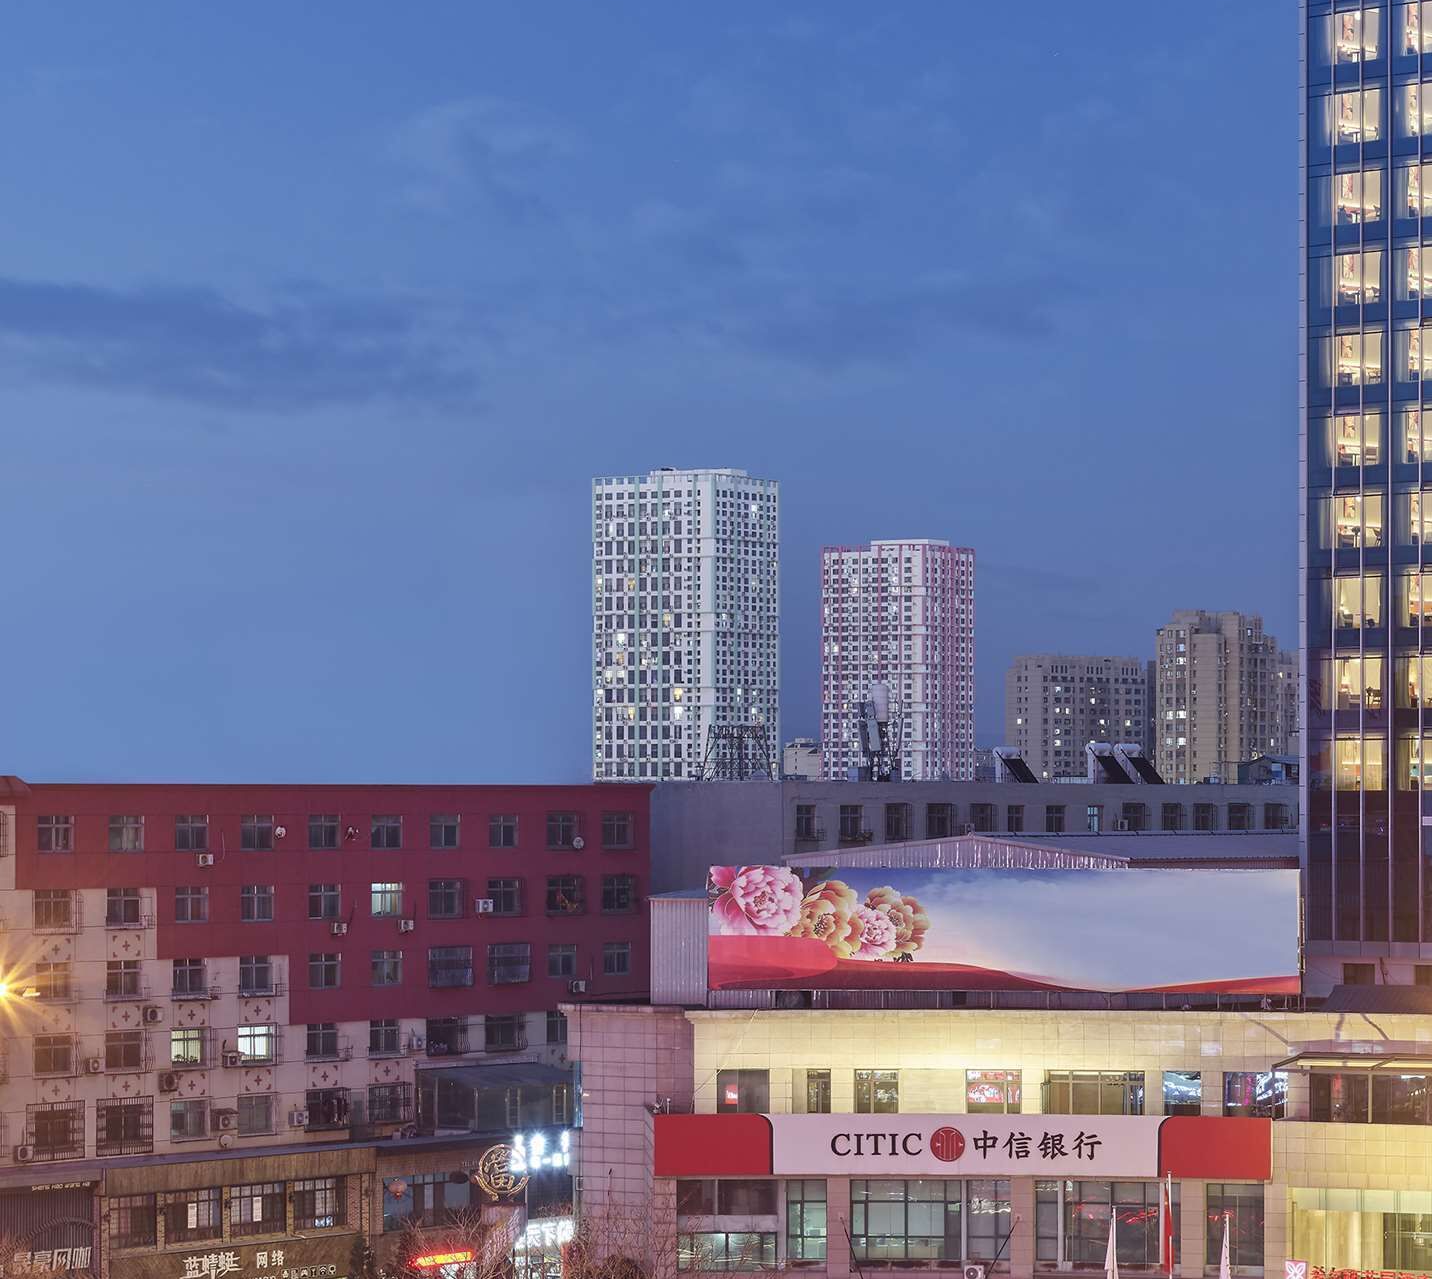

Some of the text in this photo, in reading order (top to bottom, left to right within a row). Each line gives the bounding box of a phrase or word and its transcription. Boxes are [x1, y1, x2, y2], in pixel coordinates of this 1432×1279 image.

[831, 1133, 922, 1156] CITIC
[973, 1130, 1103, 1160] 中信银行
[256, 1250, 285, 1269] 网络
